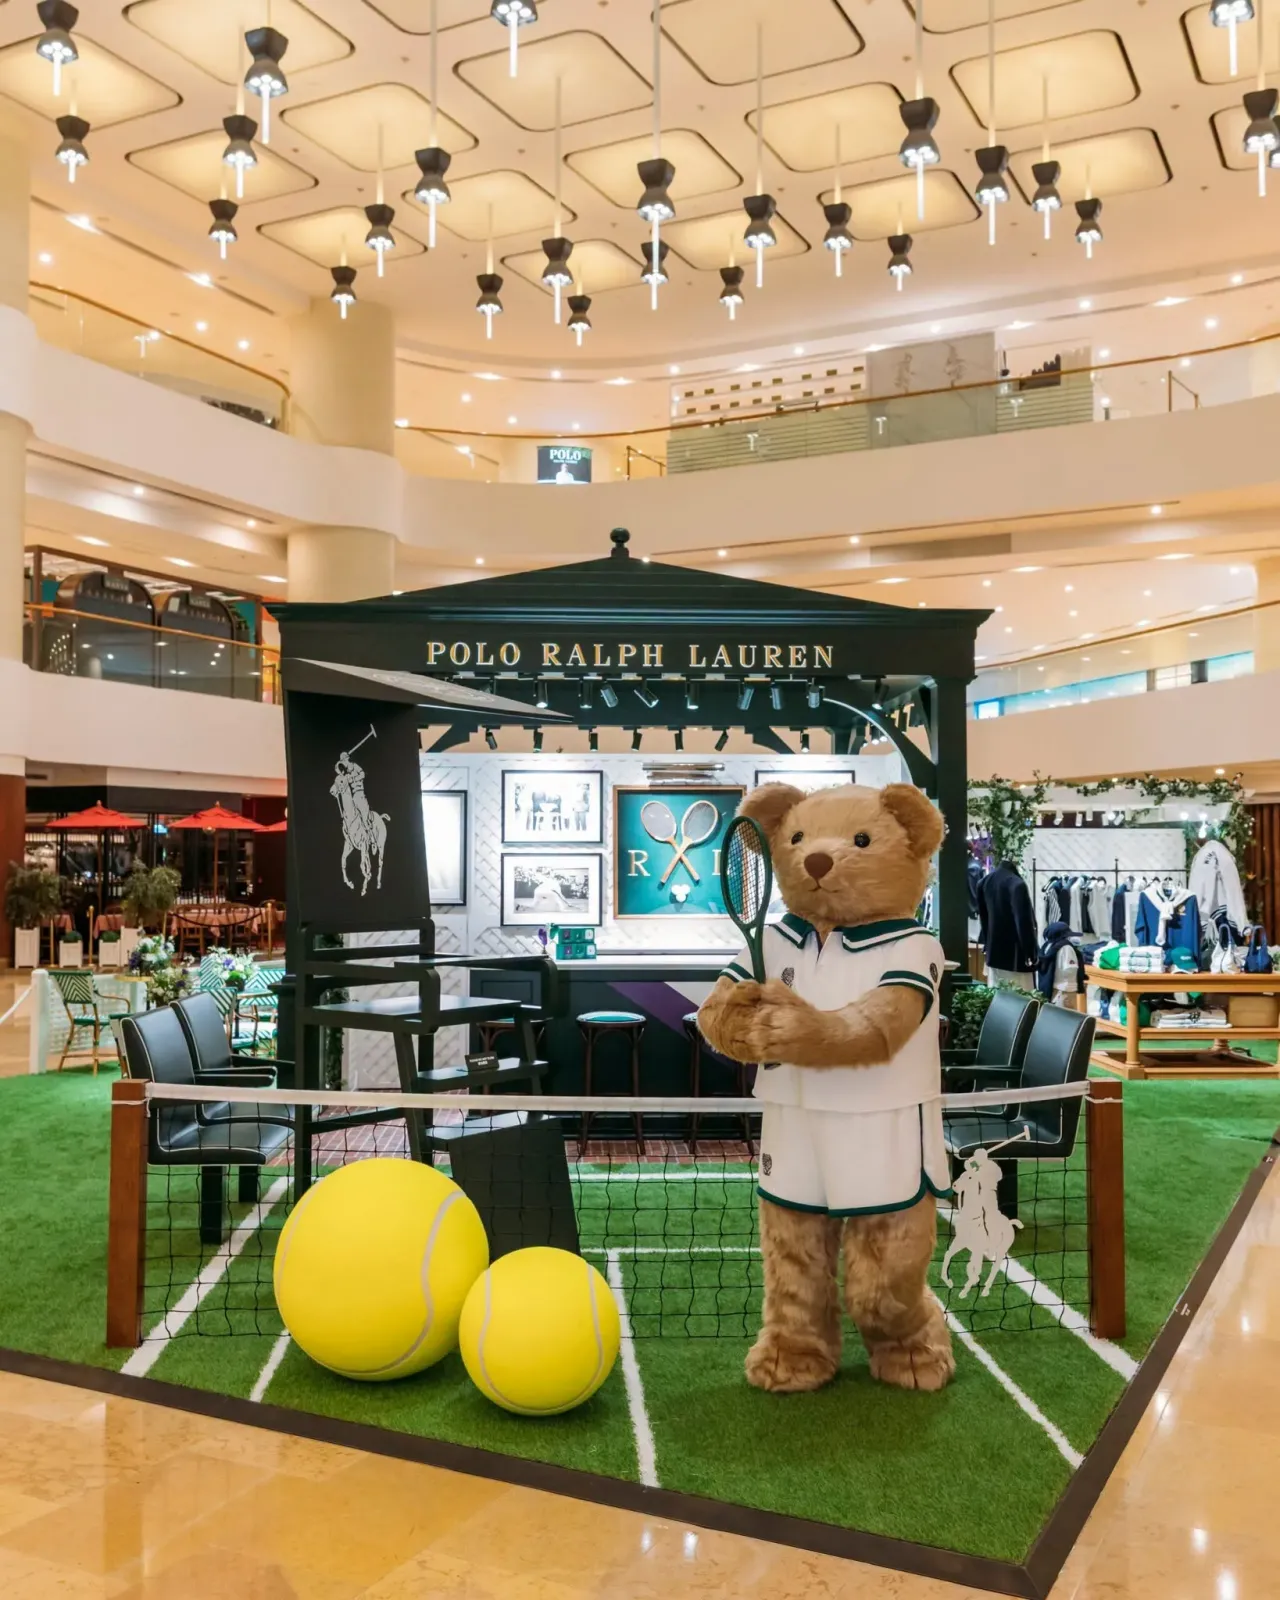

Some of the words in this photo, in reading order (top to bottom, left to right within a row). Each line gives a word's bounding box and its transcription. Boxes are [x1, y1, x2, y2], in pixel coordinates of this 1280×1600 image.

[550, 449, 582, 460] POLO
[426, 642, 521, 666] POLO
[541, 643, 664, 667] RALPH
[689, 644, 834, 668] LAUREN
[627, 849, 651, 877] R
